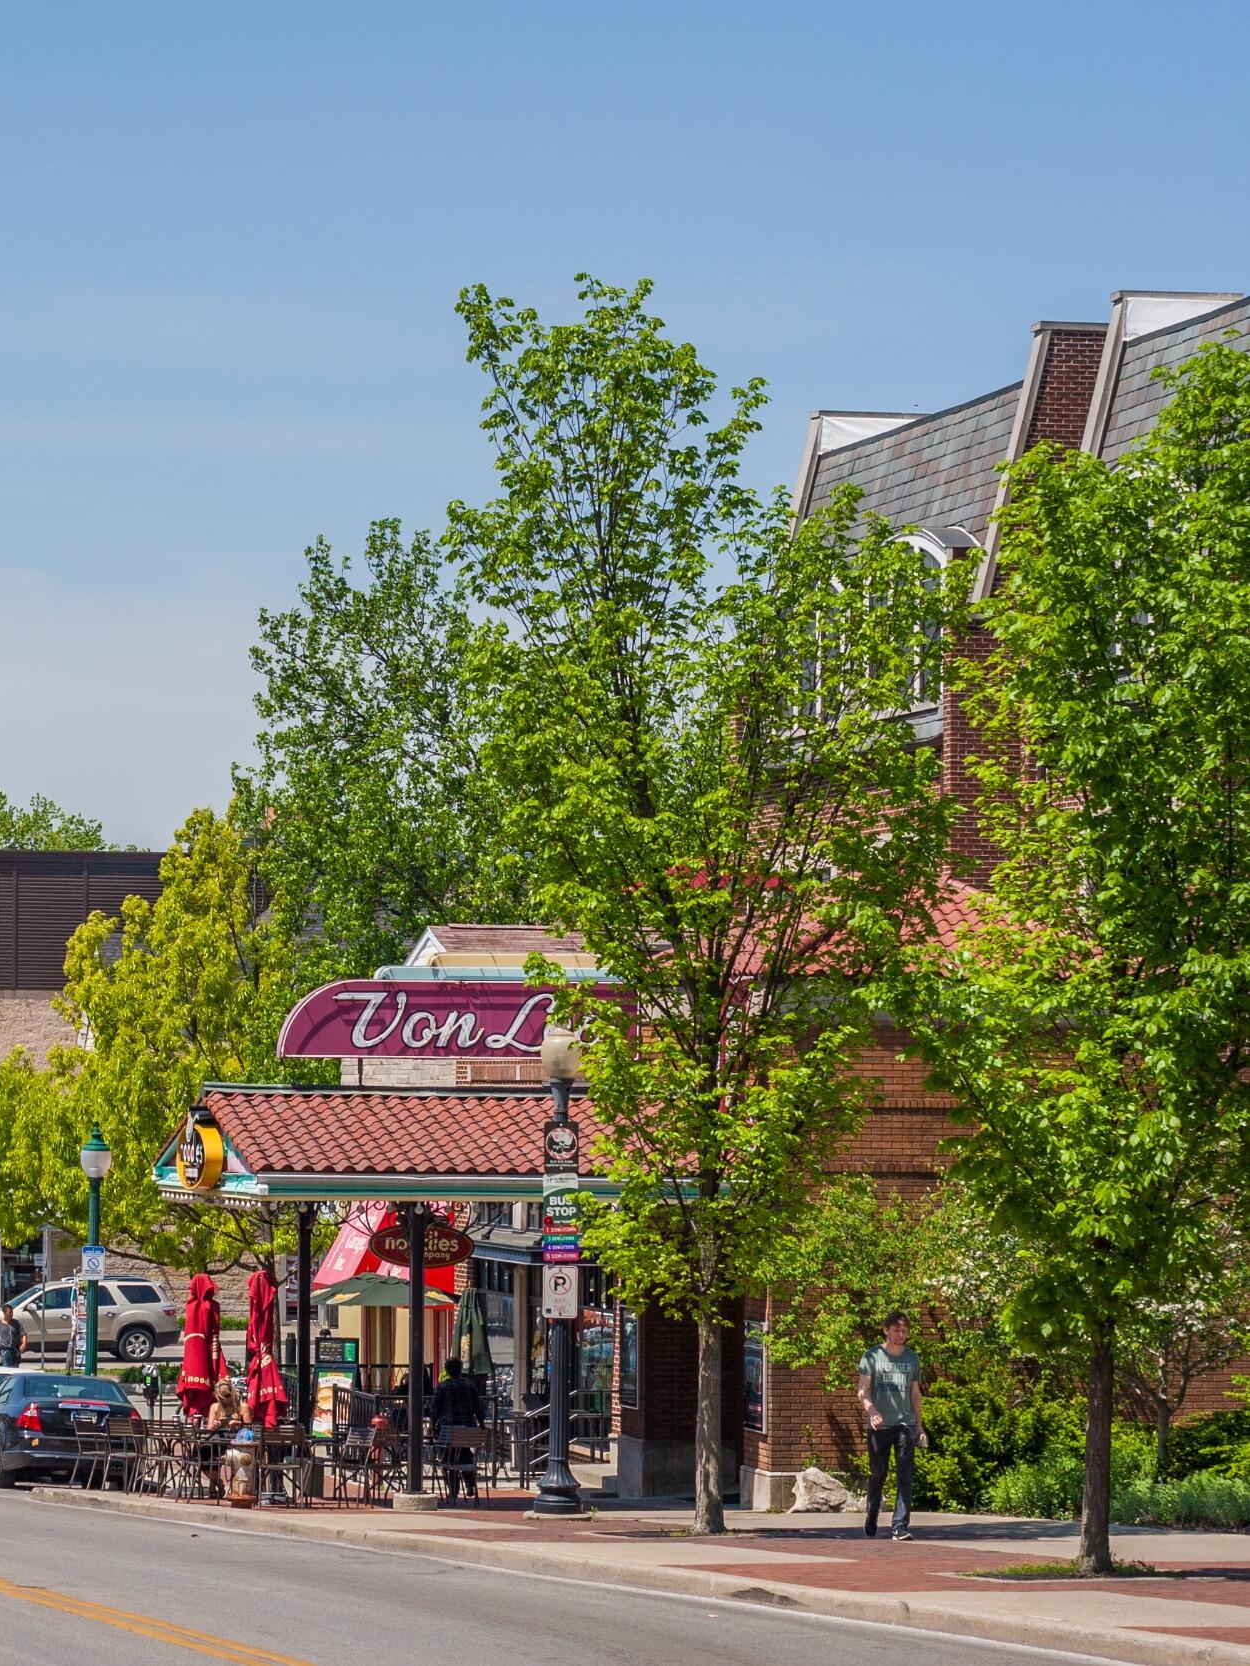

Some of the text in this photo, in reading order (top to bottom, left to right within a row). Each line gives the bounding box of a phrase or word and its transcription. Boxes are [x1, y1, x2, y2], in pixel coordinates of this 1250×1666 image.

[333, 991, 483, 1048] Von
[549, 1196, 573, 1206] BUS
[546, 1206, 577, 1217] STOP
[385, 1231, 459, 1252] nodles
